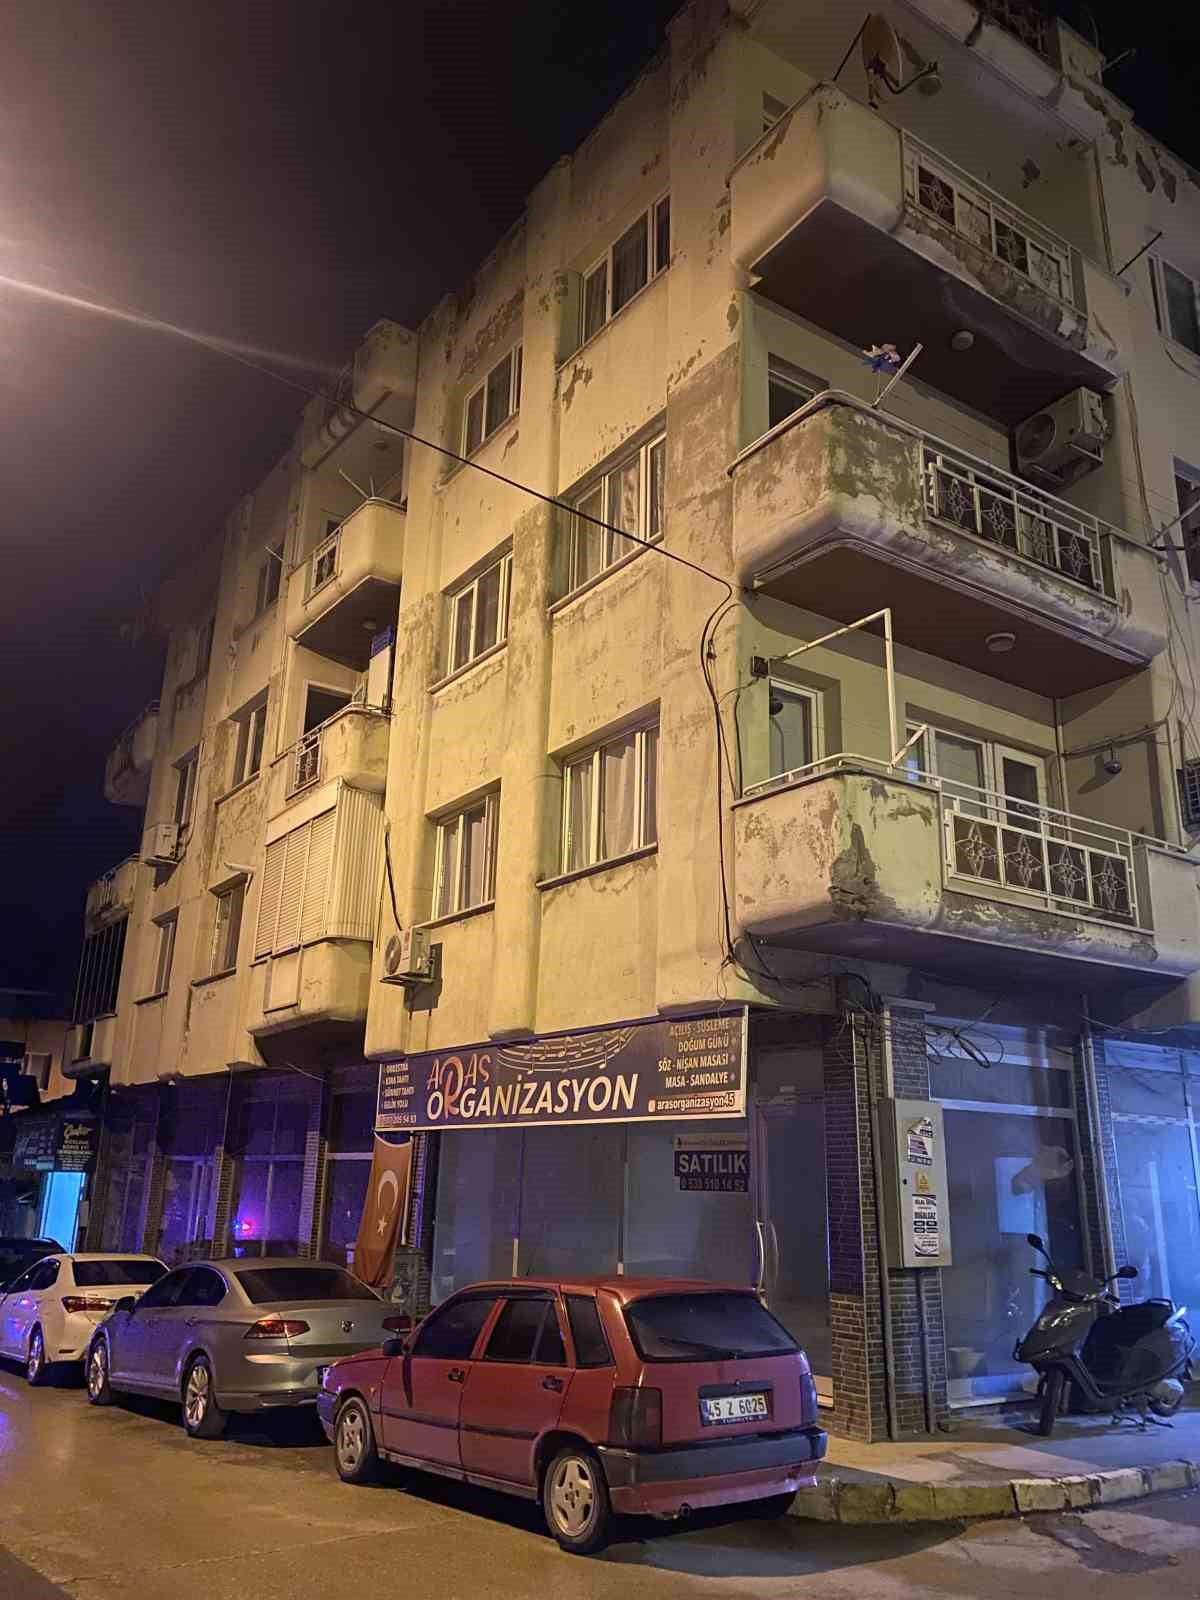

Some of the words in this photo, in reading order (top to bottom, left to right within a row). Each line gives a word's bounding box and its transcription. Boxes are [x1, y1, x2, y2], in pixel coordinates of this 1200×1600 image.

[678, 1038, 706, 1052] DOĞUM
[707, 1032, 729, 1049] GÜNÜ
[658, 1056, 672, 1071] SÖZ
[676, 1055, 699, 1072] NİŞAN
[700, 1053, 729, 1067] MASASI
[427, 1053, 491, 1119] ARAS
[666, 1075, 685, 1089] MASA
[690, 1072, 728, 1087] SANDALYE
[427, 1074, 638, 1120] ORGANİZASYON
[657, 1092, 735, 1111] arasorganizasyon45
[679, 1153, 746, 1173] SATILIK
[709, 1402, 721, 1417] 45
[739, 1397, 765, 1414] 6025
